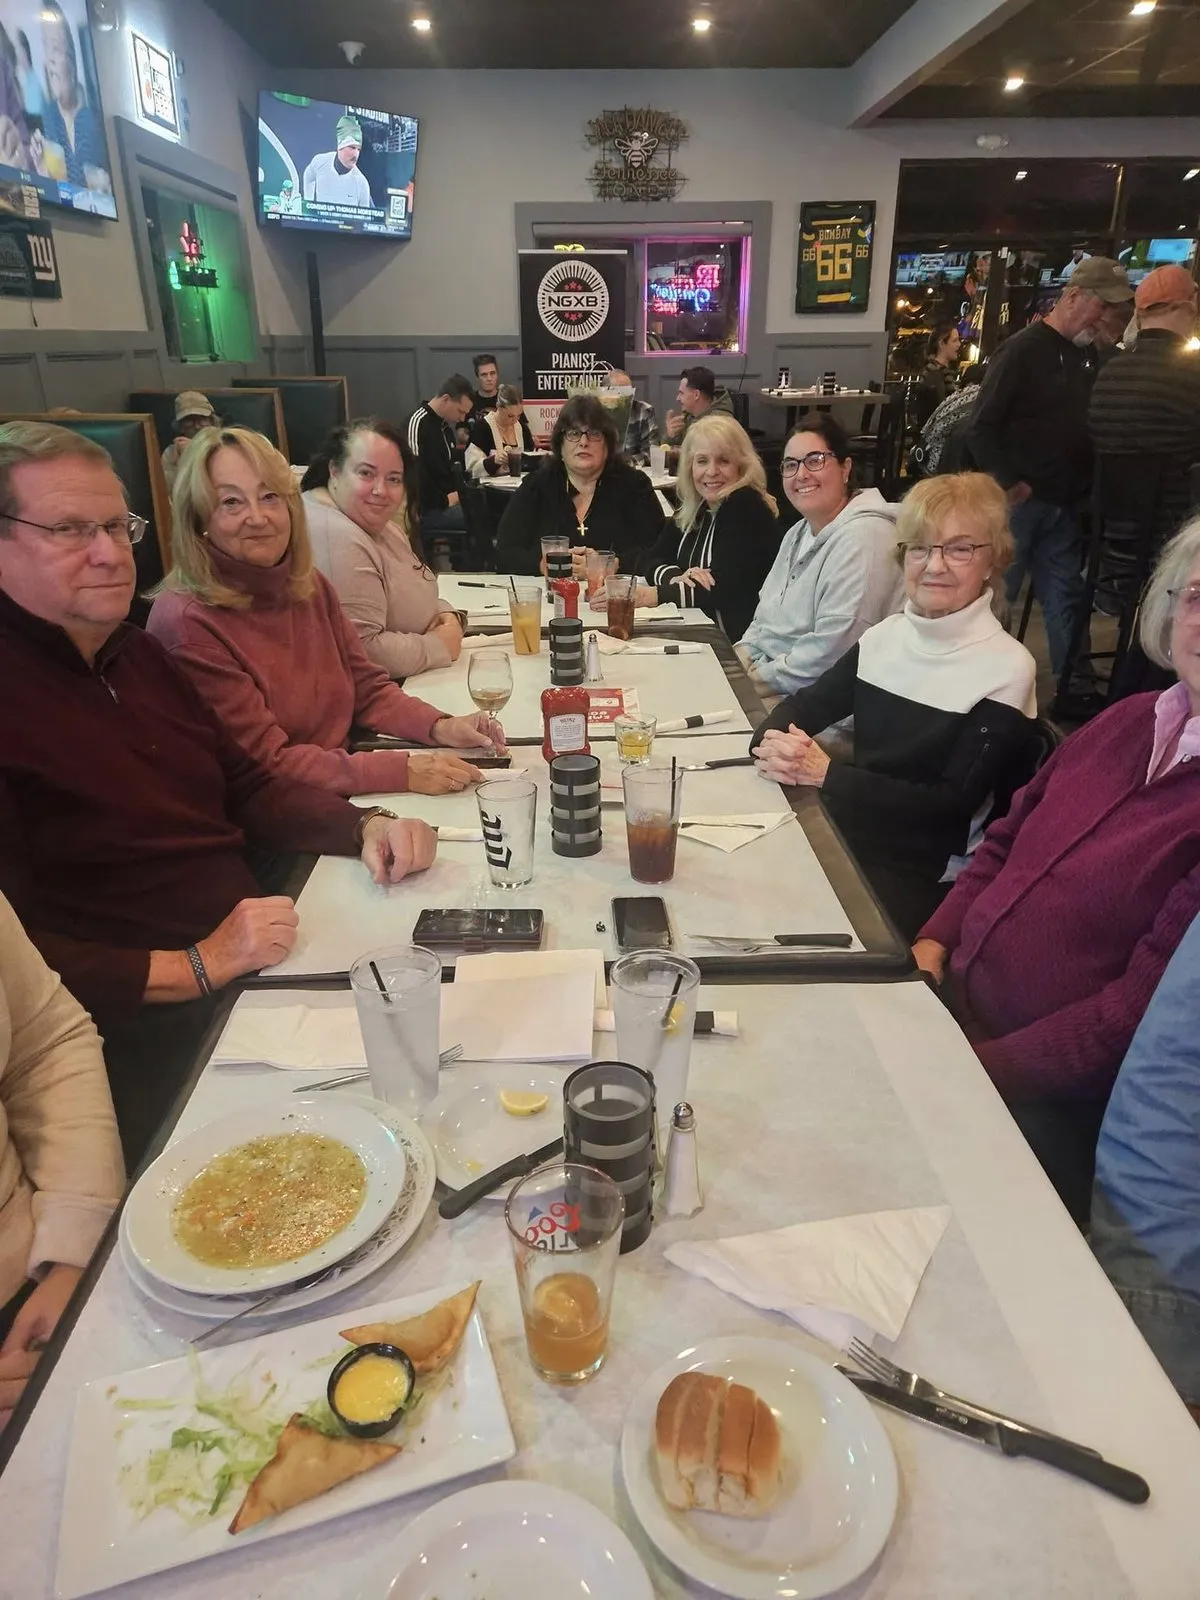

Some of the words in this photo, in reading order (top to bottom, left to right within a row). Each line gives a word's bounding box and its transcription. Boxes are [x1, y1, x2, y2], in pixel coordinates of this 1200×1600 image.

[819, 228, 851, 240] BOMBAY
[802, 248, 816, 261] 66
[855, 244, 869, 258] 66
[816, 243, 853, 281] 66
[548, 296, 598, 307] NGXB
[552, 353, 596, 369] PIANIST
[537, 374, 604, 391] ENTERTAINE
